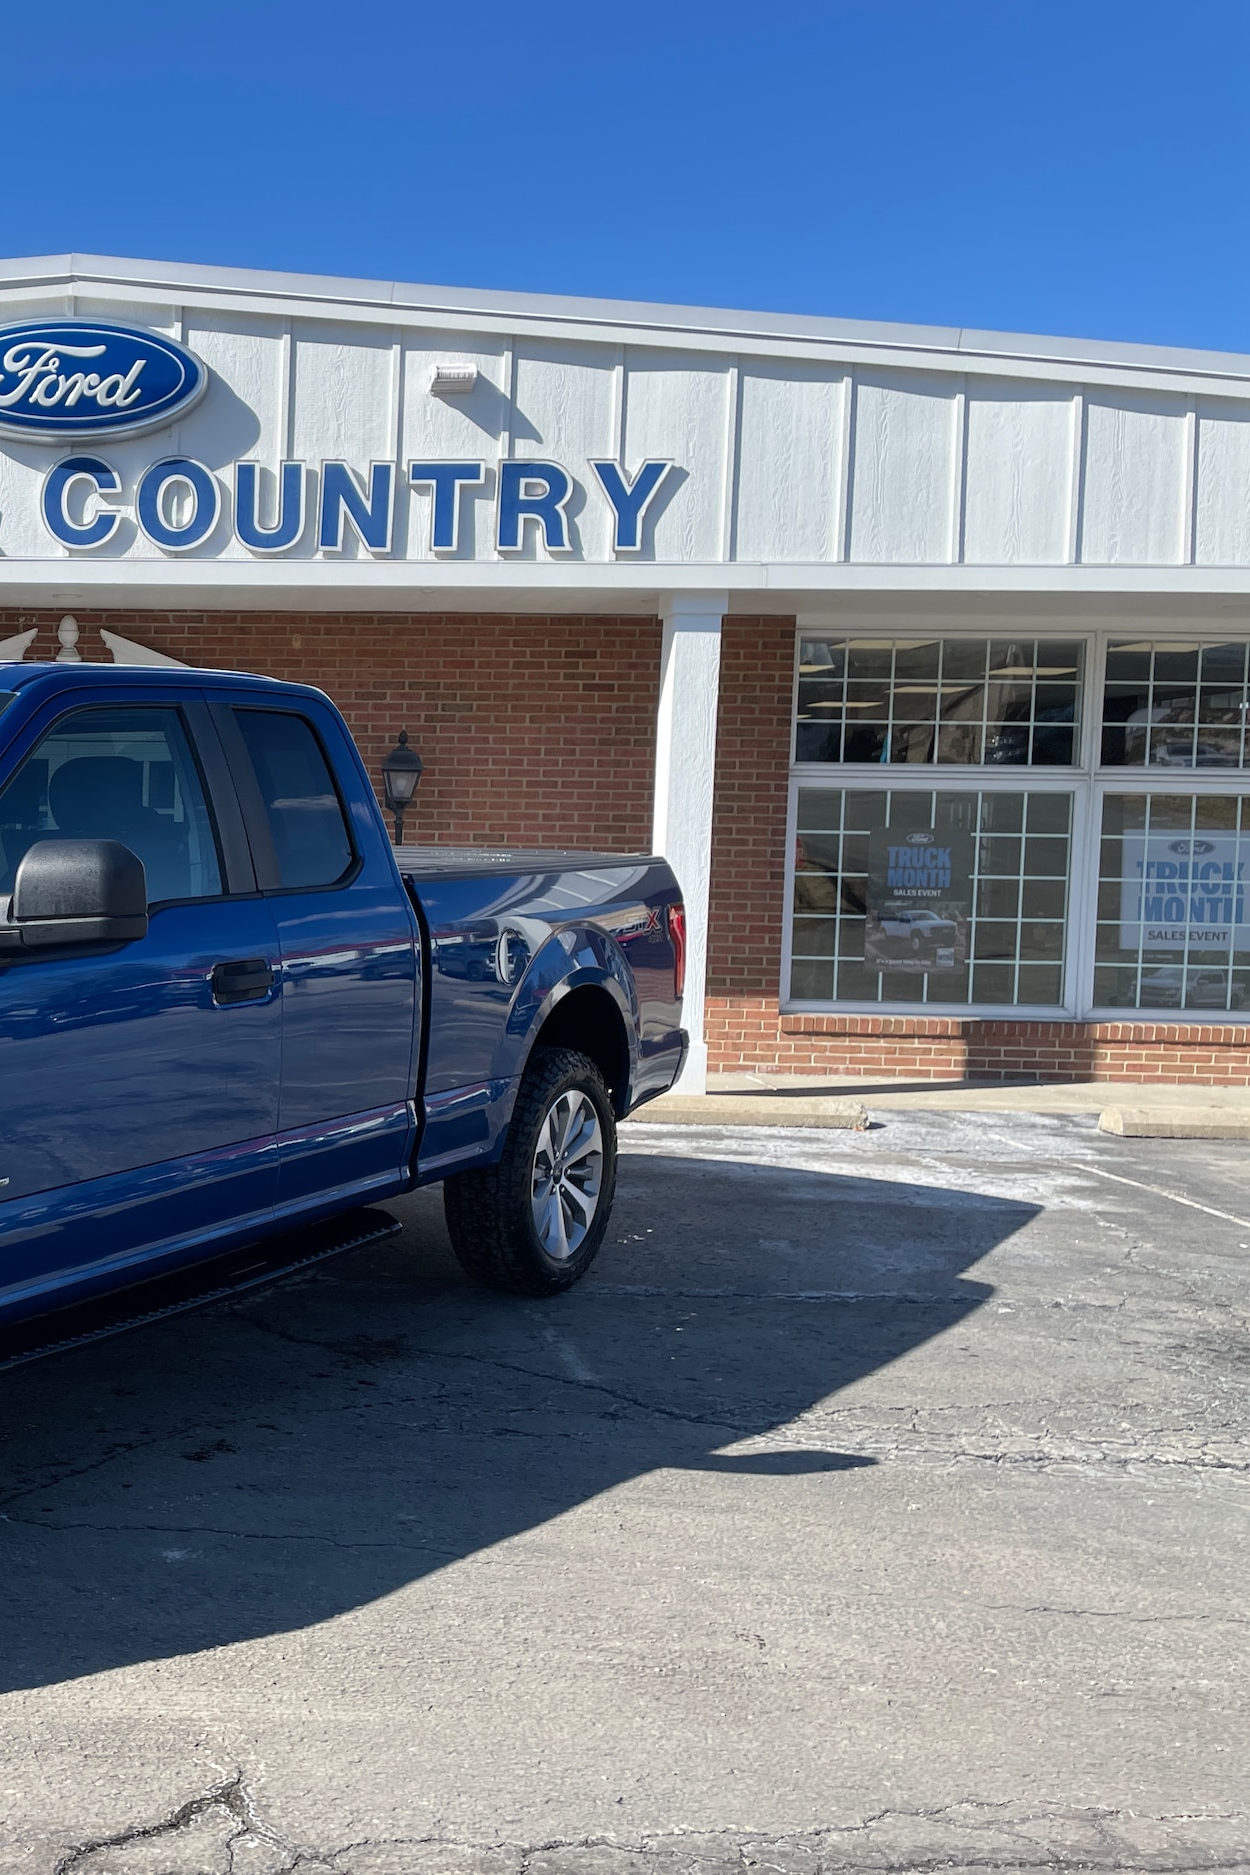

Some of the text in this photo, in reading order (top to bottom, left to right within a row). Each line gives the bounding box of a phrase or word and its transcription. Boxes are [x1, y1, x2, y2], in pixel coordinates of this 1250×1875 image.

[42, 454, 674, 552] COUNTRY
[887, 846, 952, 868] TRUCK
[887, 868, 951, 888] MONTH
[1136, 861, 1245, 895] TRUCK
[918, 889, 942, 897] EVENT
[1137, 896, 1244, 924] MONTH
[1148, 930, 1228, 941] SALES EVENT
